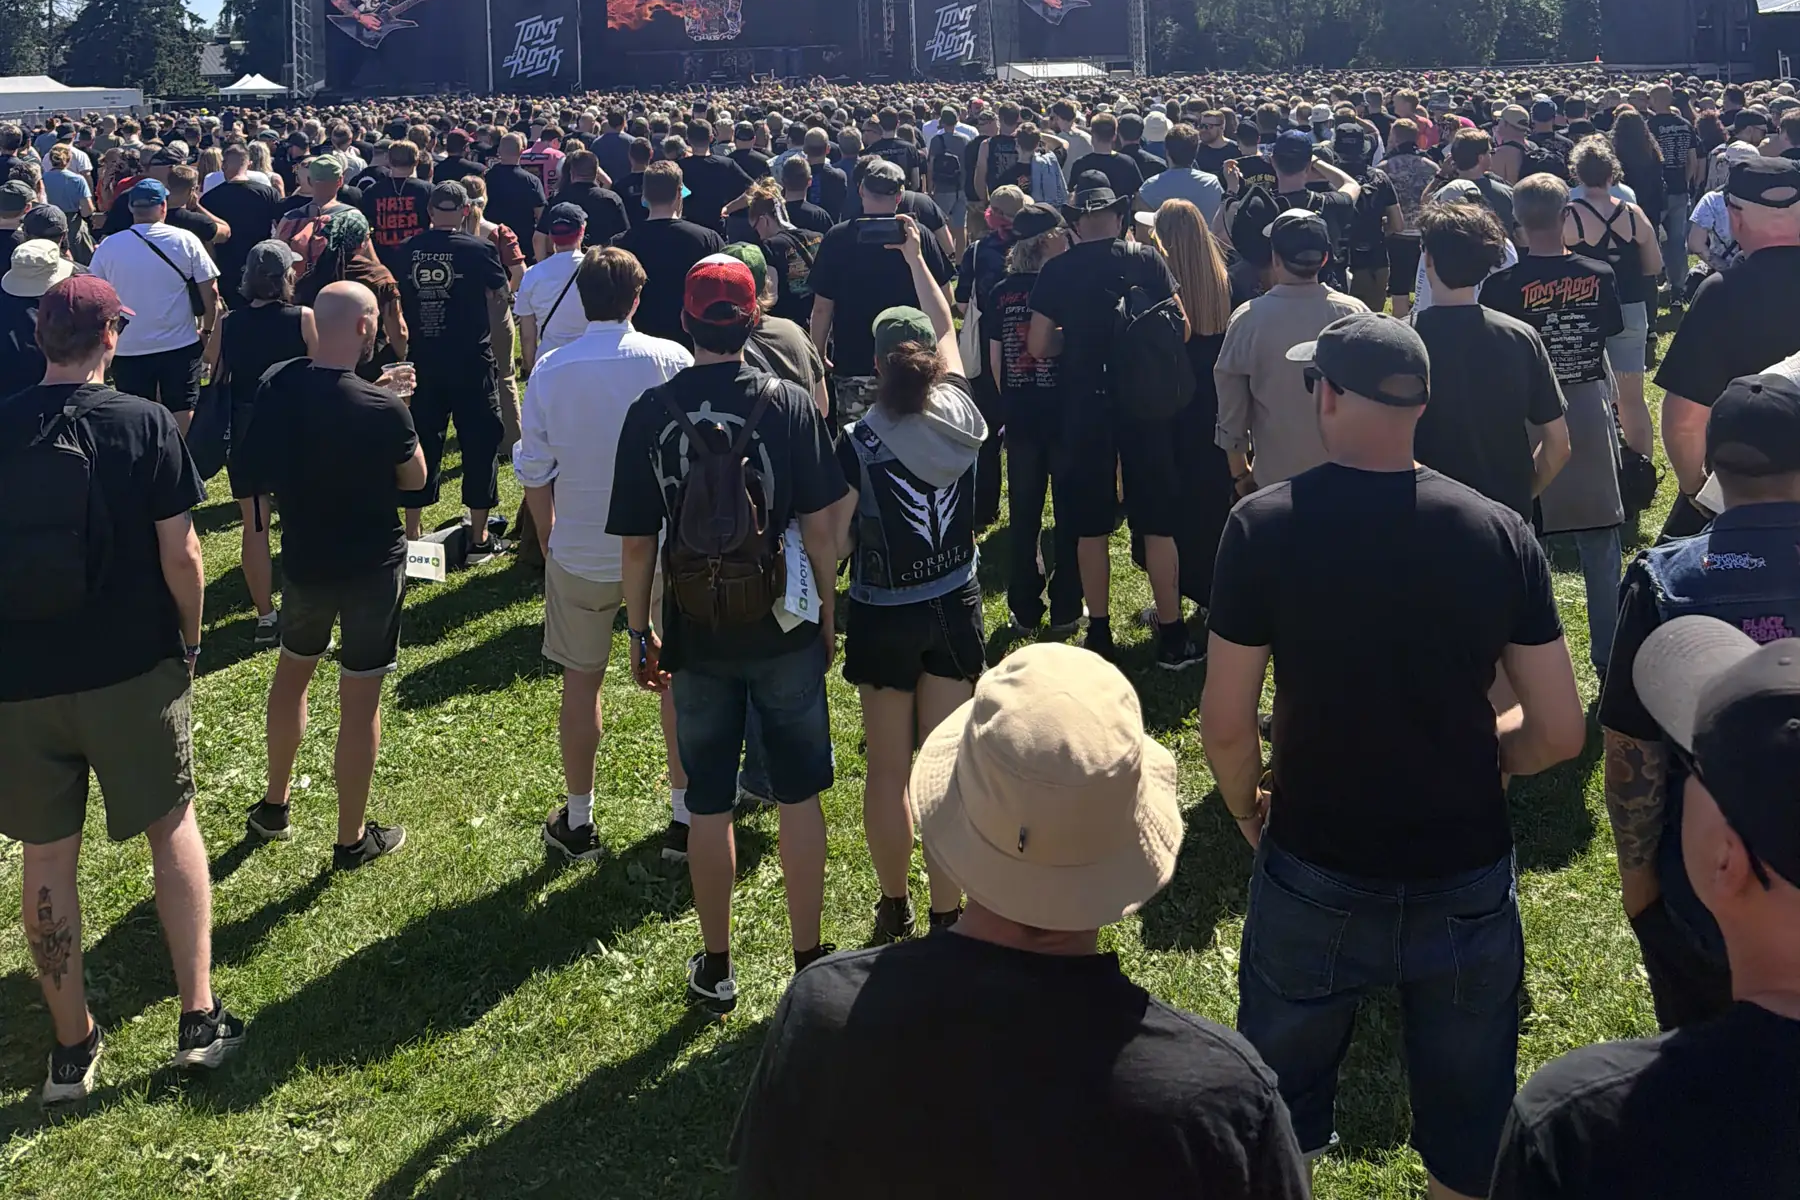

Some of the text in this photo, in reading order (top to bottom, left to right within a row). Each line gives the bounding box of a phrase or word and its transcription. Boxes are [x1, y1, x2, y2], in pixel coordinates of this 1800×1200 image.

[514, 14, 564, 52] TONS
[934, 1, 977, 37] TONS
[925, 30, 978, 62] ROCK
[502, 45, 564, 79] ROCK
[375, 196, 415, 212] HATE
[411, 249, 454, 262] Ayreon
[419, 268, 445, 282] 30
[1559, 275, 1600, 306] ROCK
[901, 549, 969, 581] CULTURE
[912, 545, 960, 570] ORBIT
[1742, 616, 1784, 630] BLACK
